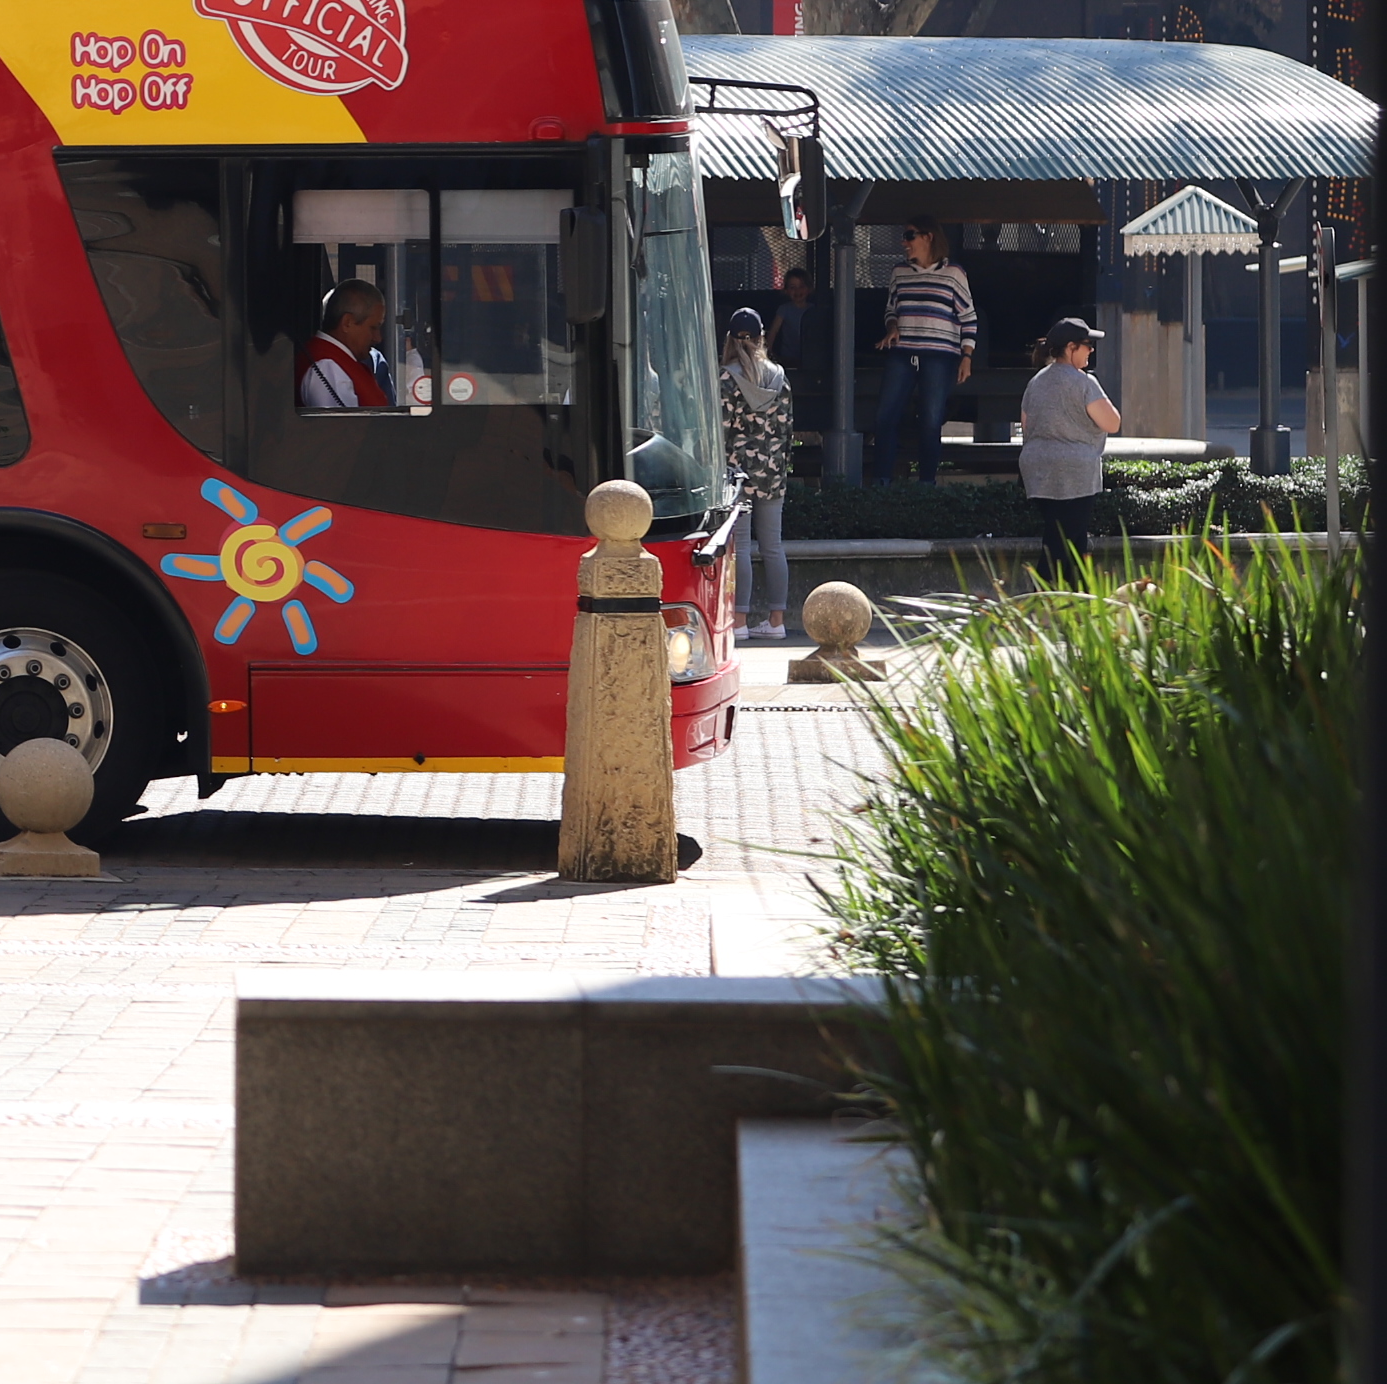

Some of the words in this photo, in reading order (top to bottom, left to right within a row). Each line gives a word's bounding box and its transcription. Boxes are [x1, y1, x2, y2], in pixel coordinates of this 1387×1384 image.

[71, 32, 136, 72] Hop
[139, 29, 185, 69] On
[281, 43, 336, 80] TOUR
[71, 74, 137, 115] Hop
[140, 71, 193, 111] Off
